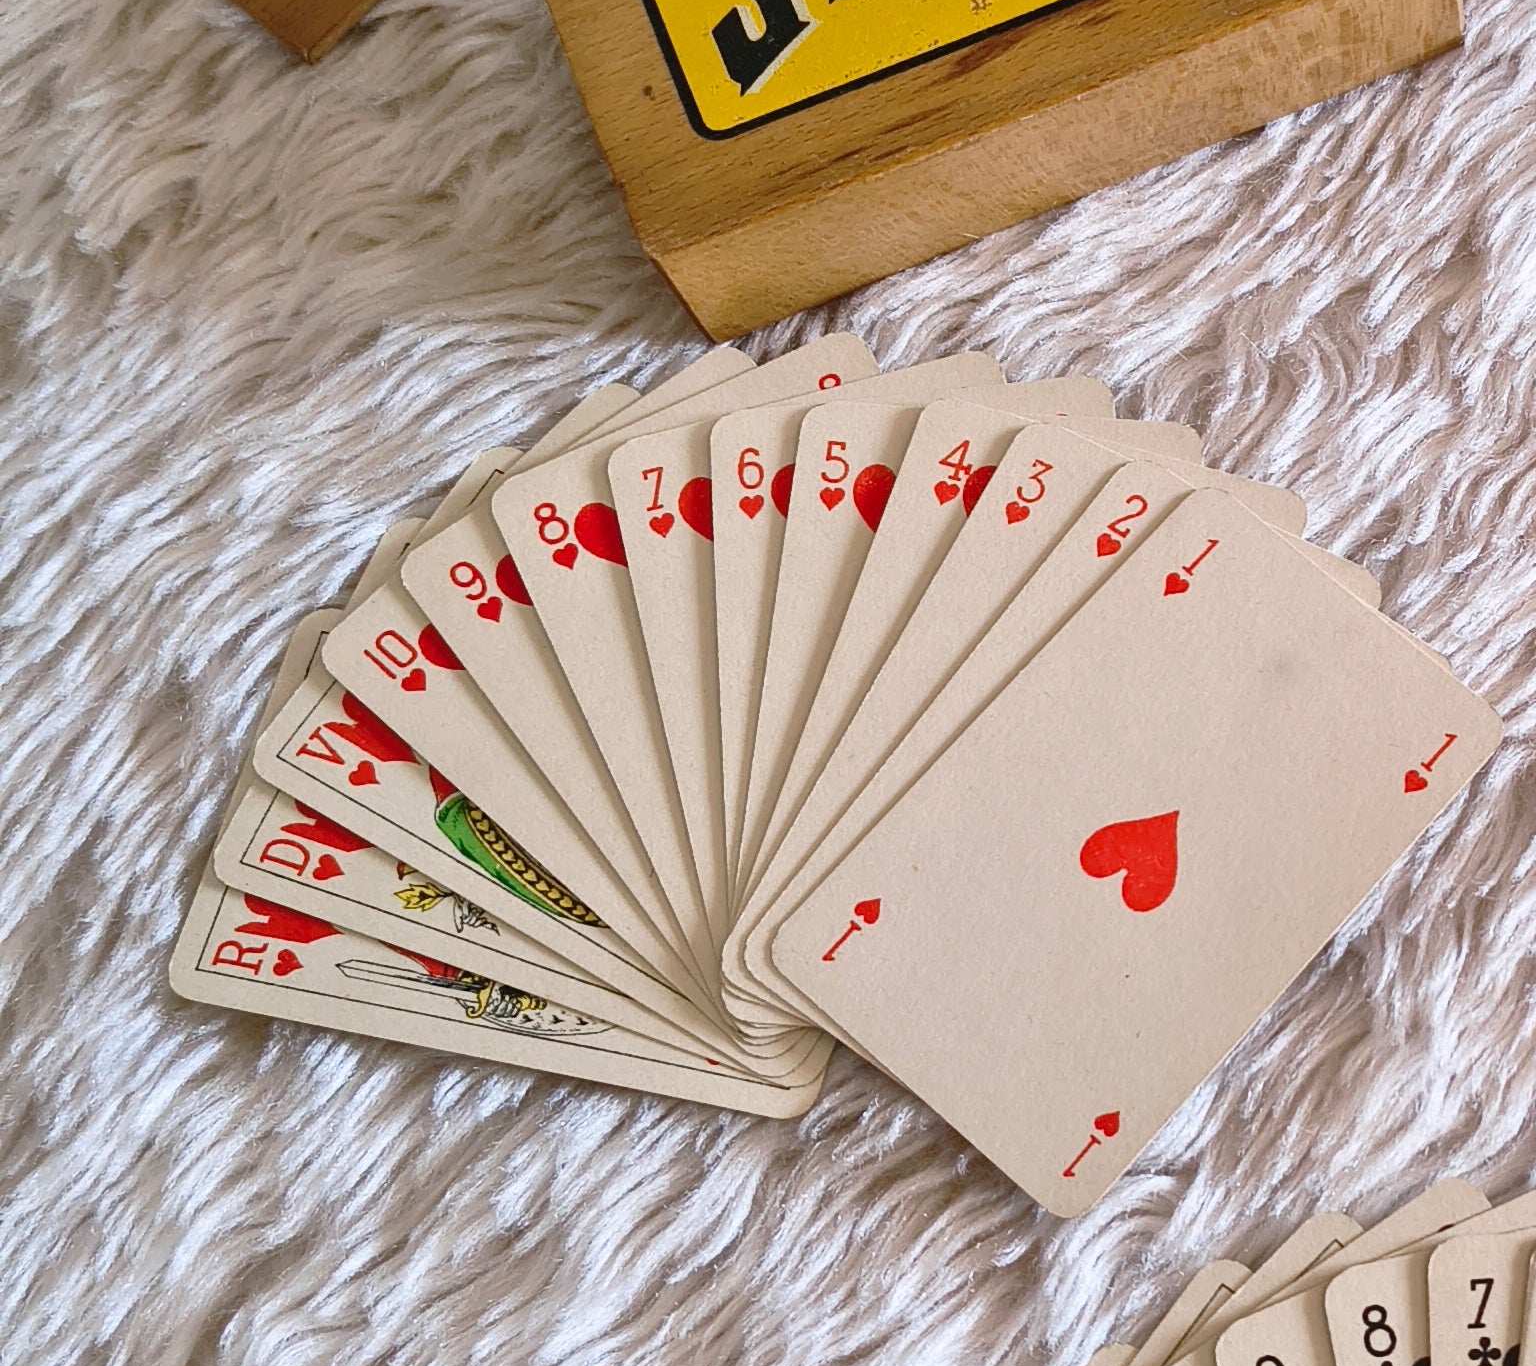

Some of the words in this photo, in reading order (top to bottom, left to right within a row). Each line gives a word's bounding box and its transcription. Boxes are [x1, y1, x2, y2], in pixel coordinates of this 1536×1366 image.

[736, 447, 765, 491] 6
[819, 440, 849, 485] 5
[937, 438, 972, 481] 4
[640, 466, 663, 513] 7
[1015, 460, 1053, 505] 3
[532, 502, 570, 547] 8
[1106, 494, 1149, 540] 2
[448, 561, 487, 603] 9
[363, 629, 419, 681] 10
[295, 727, 345, 767] V
[258, 838, 311, 878] D
[211, 940, 268, 976] R
[1467, 1277, 1494, 1329] 7
[1362, 1304, 1397, 1358] 8
